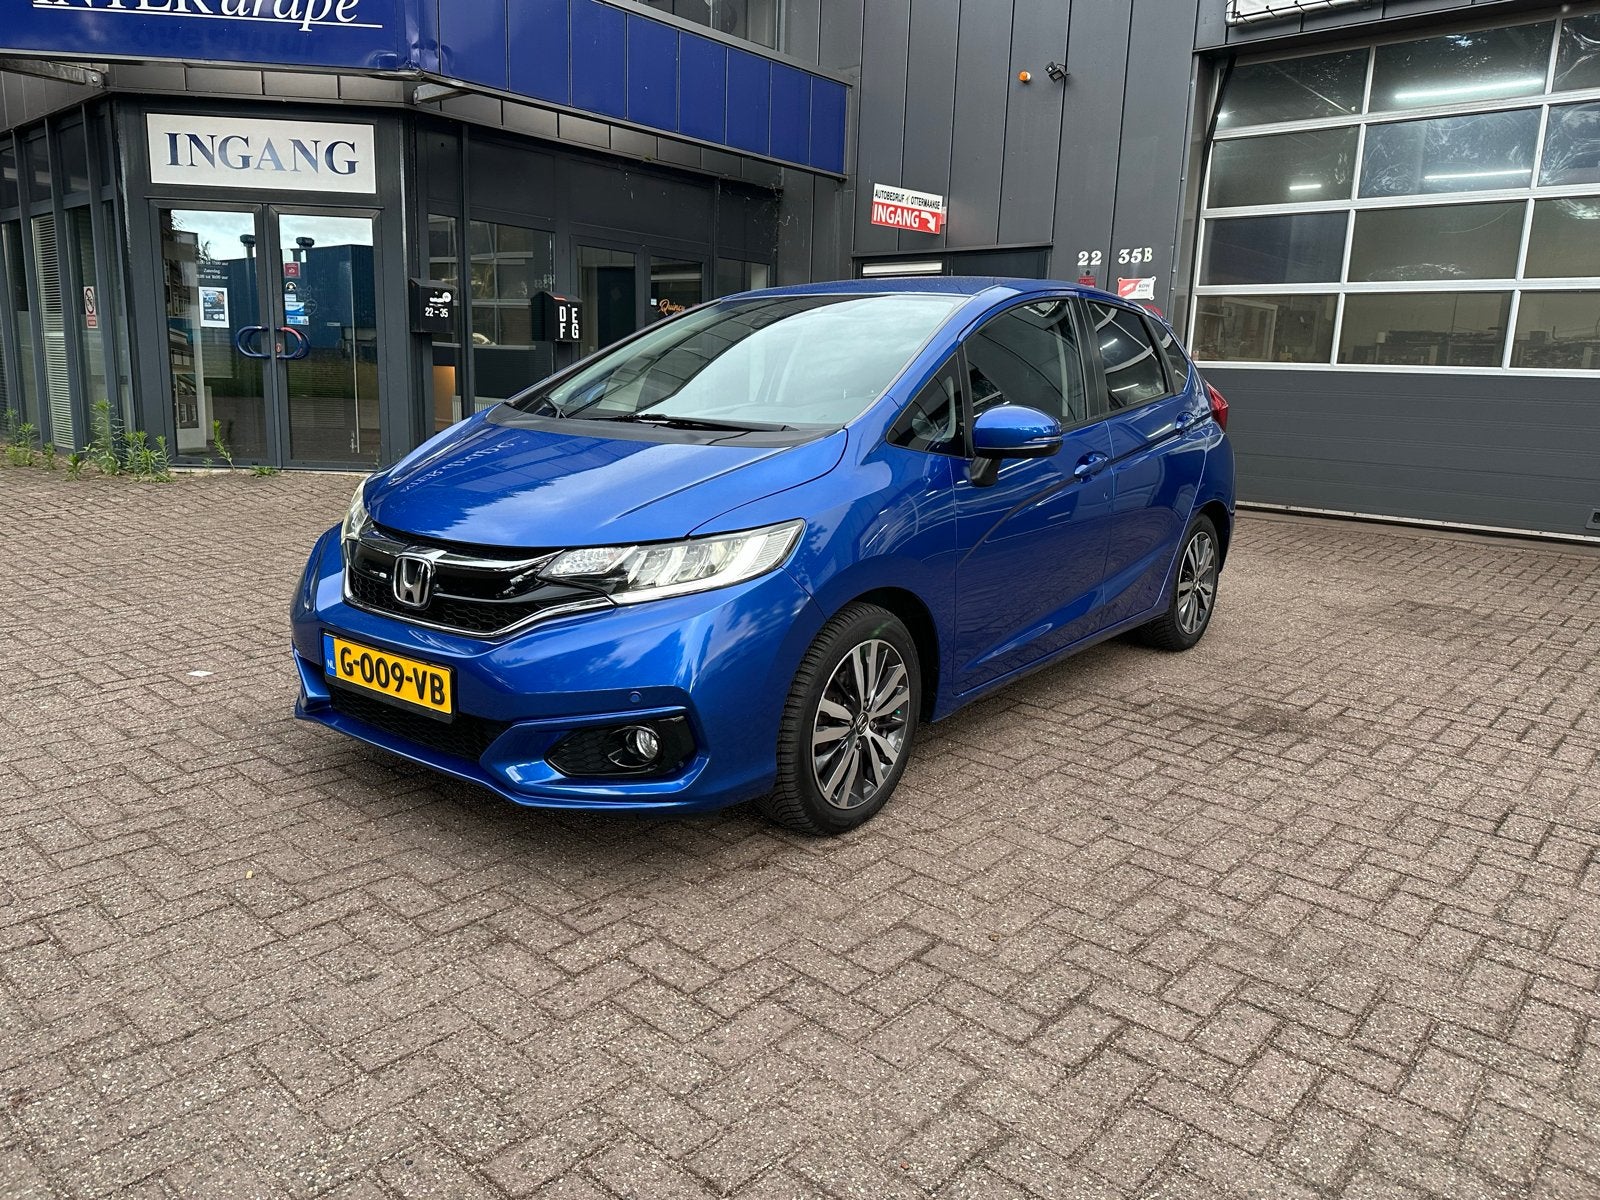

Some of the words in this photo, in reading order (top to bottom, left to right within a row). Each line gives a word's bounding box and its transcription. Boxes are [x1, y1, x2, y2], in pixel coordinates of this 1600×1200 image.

[164, 132, 359, 175] INGANG
[875, 189, 905, 203] AUTOBEDRIJF
[873, 204, 920, 228] INGANG
[1077, 250, 1103, 266] 22
[1118, 247, 1153, 264] 35B
[559, 305, 567, 322] D
[571, 307, 579, 324] E
[559, 322, 567, 339] F
[571, 323, 580, 339] G
[327, 659, 336, 670] NL
[341, 647, 445, 705] G-009-VB
